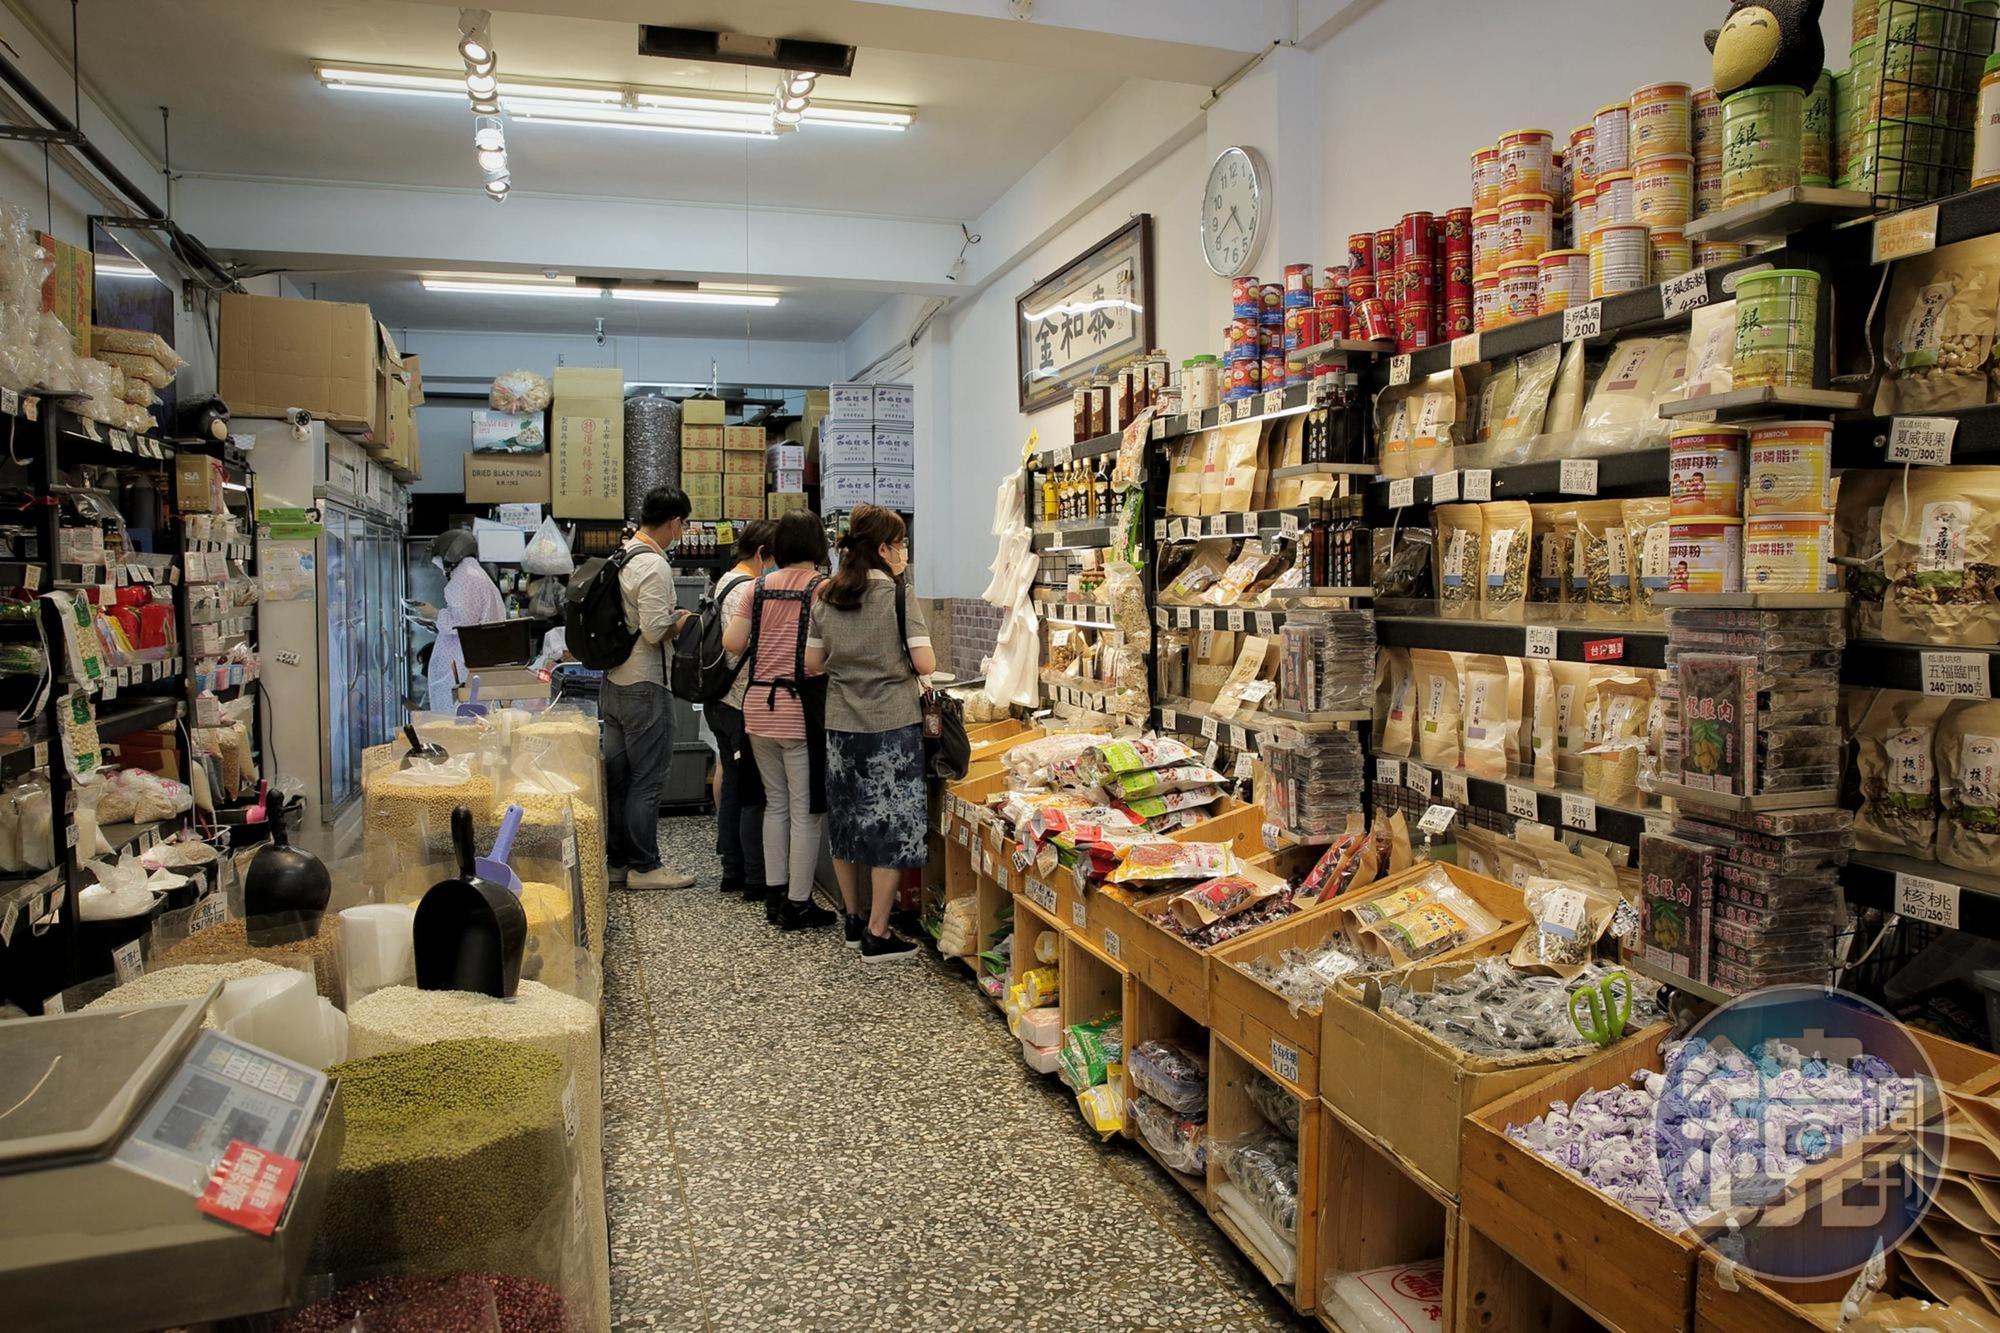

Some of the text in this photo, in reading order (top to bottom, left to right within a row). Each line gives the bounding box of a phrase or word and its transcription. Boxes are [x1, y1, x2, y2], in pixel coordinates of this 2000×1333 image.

[1680, 295, 1708, 311] 450
[1896, 430, 1946, 447] 夏威夷果
[1533, 645, 1550, 655] 230
[1928, 664, 1981, 680] 五福臨門
[1929, 681, 1984, 697] 240元/300克
[1686, 696, 1734, 723] 龍眼肉
[1903, 756, 1918, 785] 核桃
[1970, 767, 1983, 797] 核桃
[1513, 806, 1533, 818] 200
[1647, 873, 1692, 907] 龍眼肉
[1902, 887, 1952, 911] 核桃
[1903, 903, 1952, 926] 140元/250克
